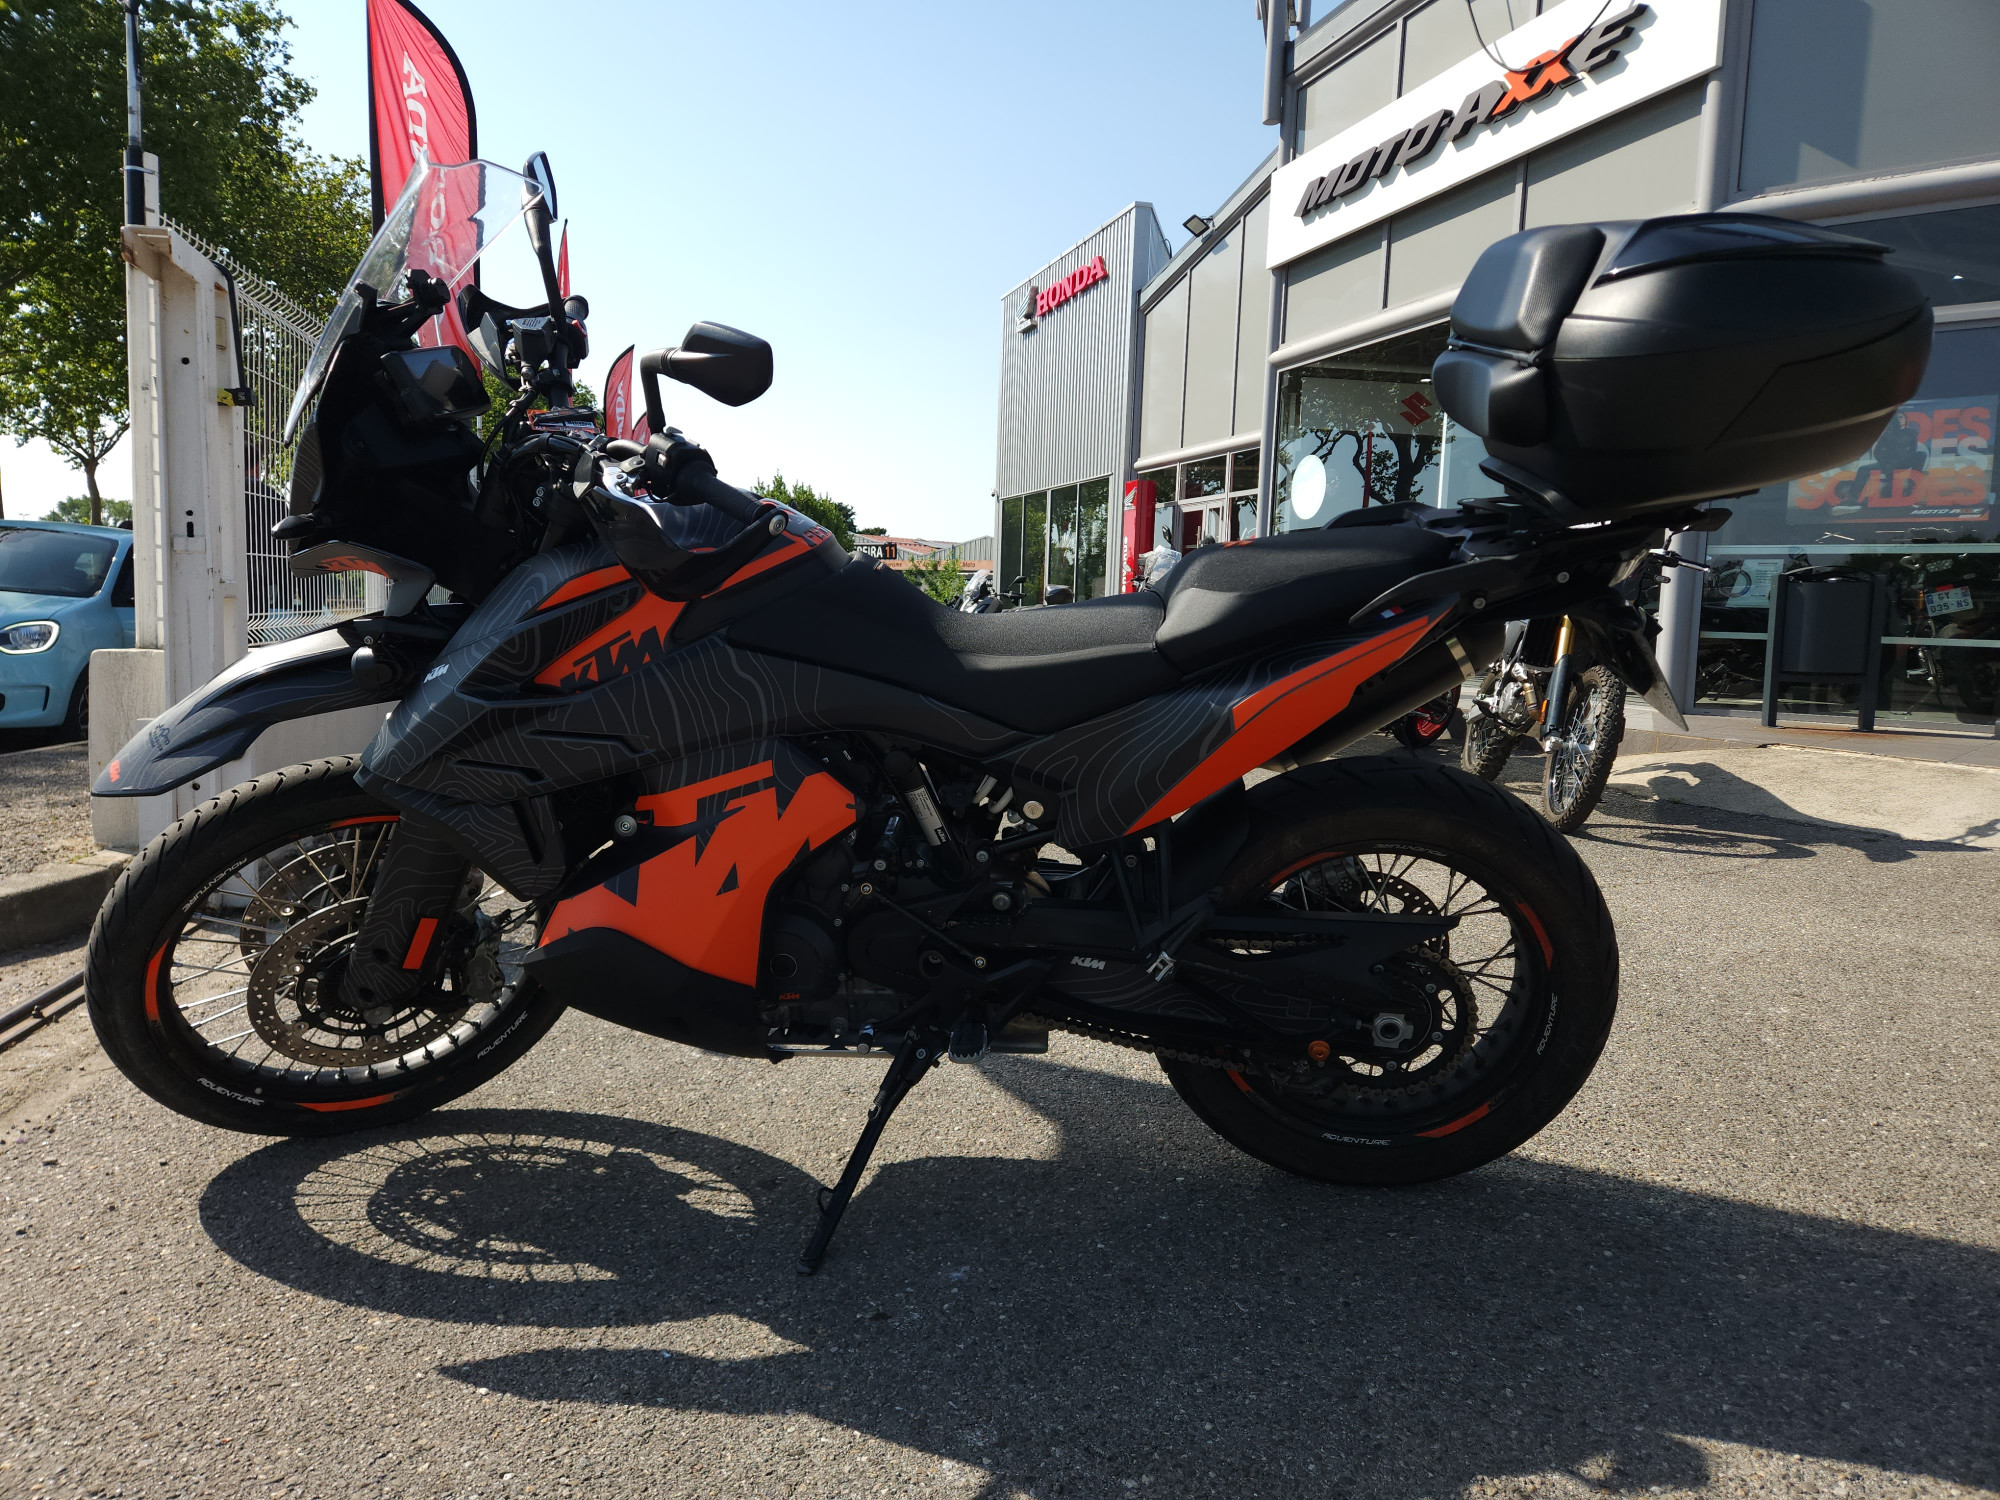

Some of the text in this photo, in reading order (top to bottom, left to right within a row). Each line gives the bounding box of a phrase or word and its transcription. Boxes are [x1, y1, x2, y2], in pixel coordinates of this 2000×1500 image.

[1036, 255, 1108, 317] HONDA
[885, 545, 896, 558] 11
[423, 663, 450, 683] KTM
[560, 625, 665, 693] KTM
[1070, 955, 1107, 970] KTM
[476, 1010, 529, 1060] ADVENTURE
[1536, 992, 1558, 1056] ADVENTURE
[197, 1077, 265, 1106] ADVENTURE
[1321, 1132, 1392, 1146] ADVENTURE
